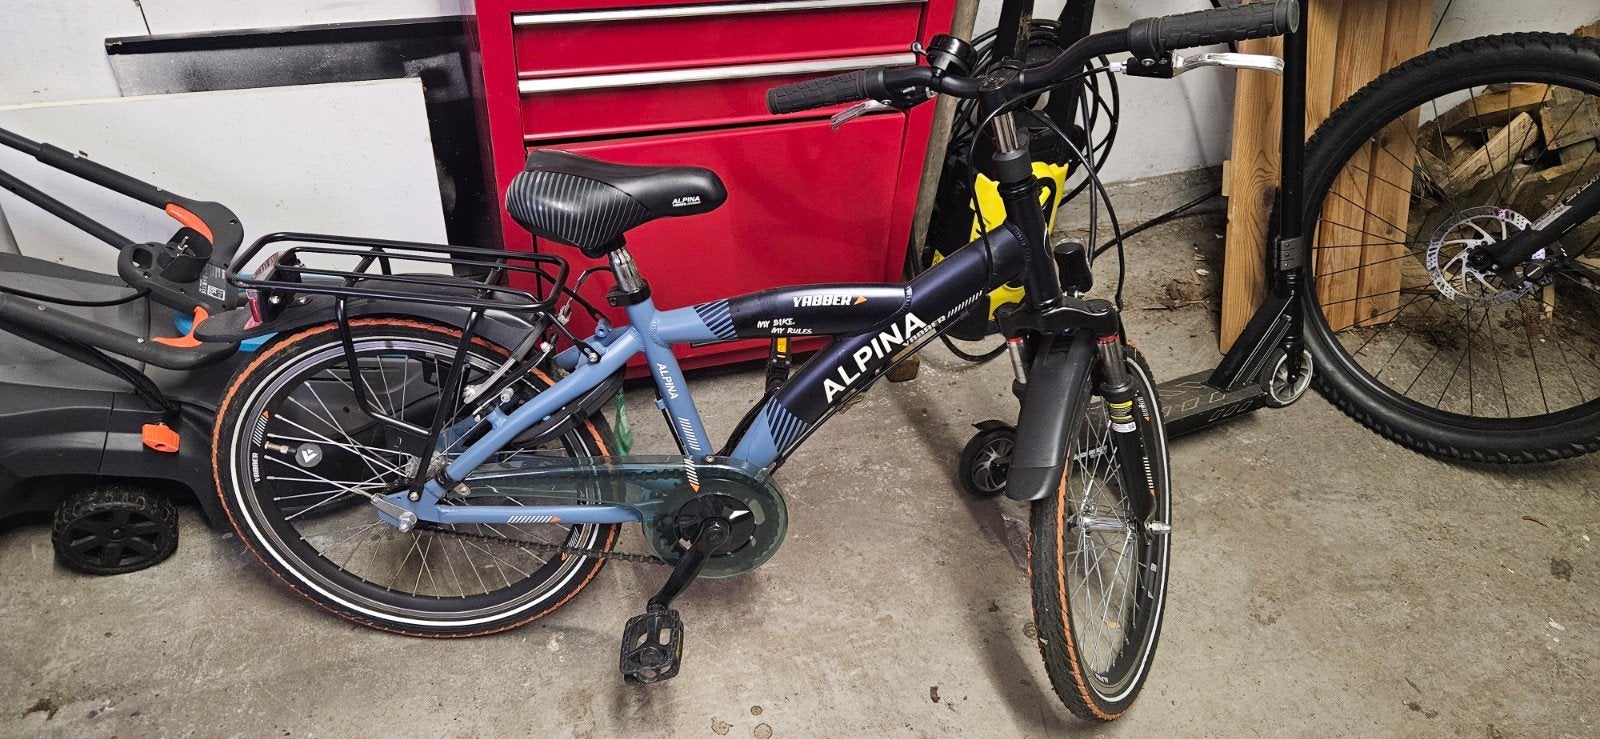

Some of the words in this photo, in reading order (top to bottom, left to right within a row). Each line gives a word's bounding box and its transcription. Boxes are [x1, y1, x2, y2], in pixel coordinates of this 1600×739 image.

[672, 196, 701, 204] ALPINA
[793, 295, 853, 307] YABBER
[757, 320, 770, 328] MY
[771, 327, 785, 335] MY
[823, 312, 928, 404] ALPINA
[657, 363, 679, 399] ALPINA
